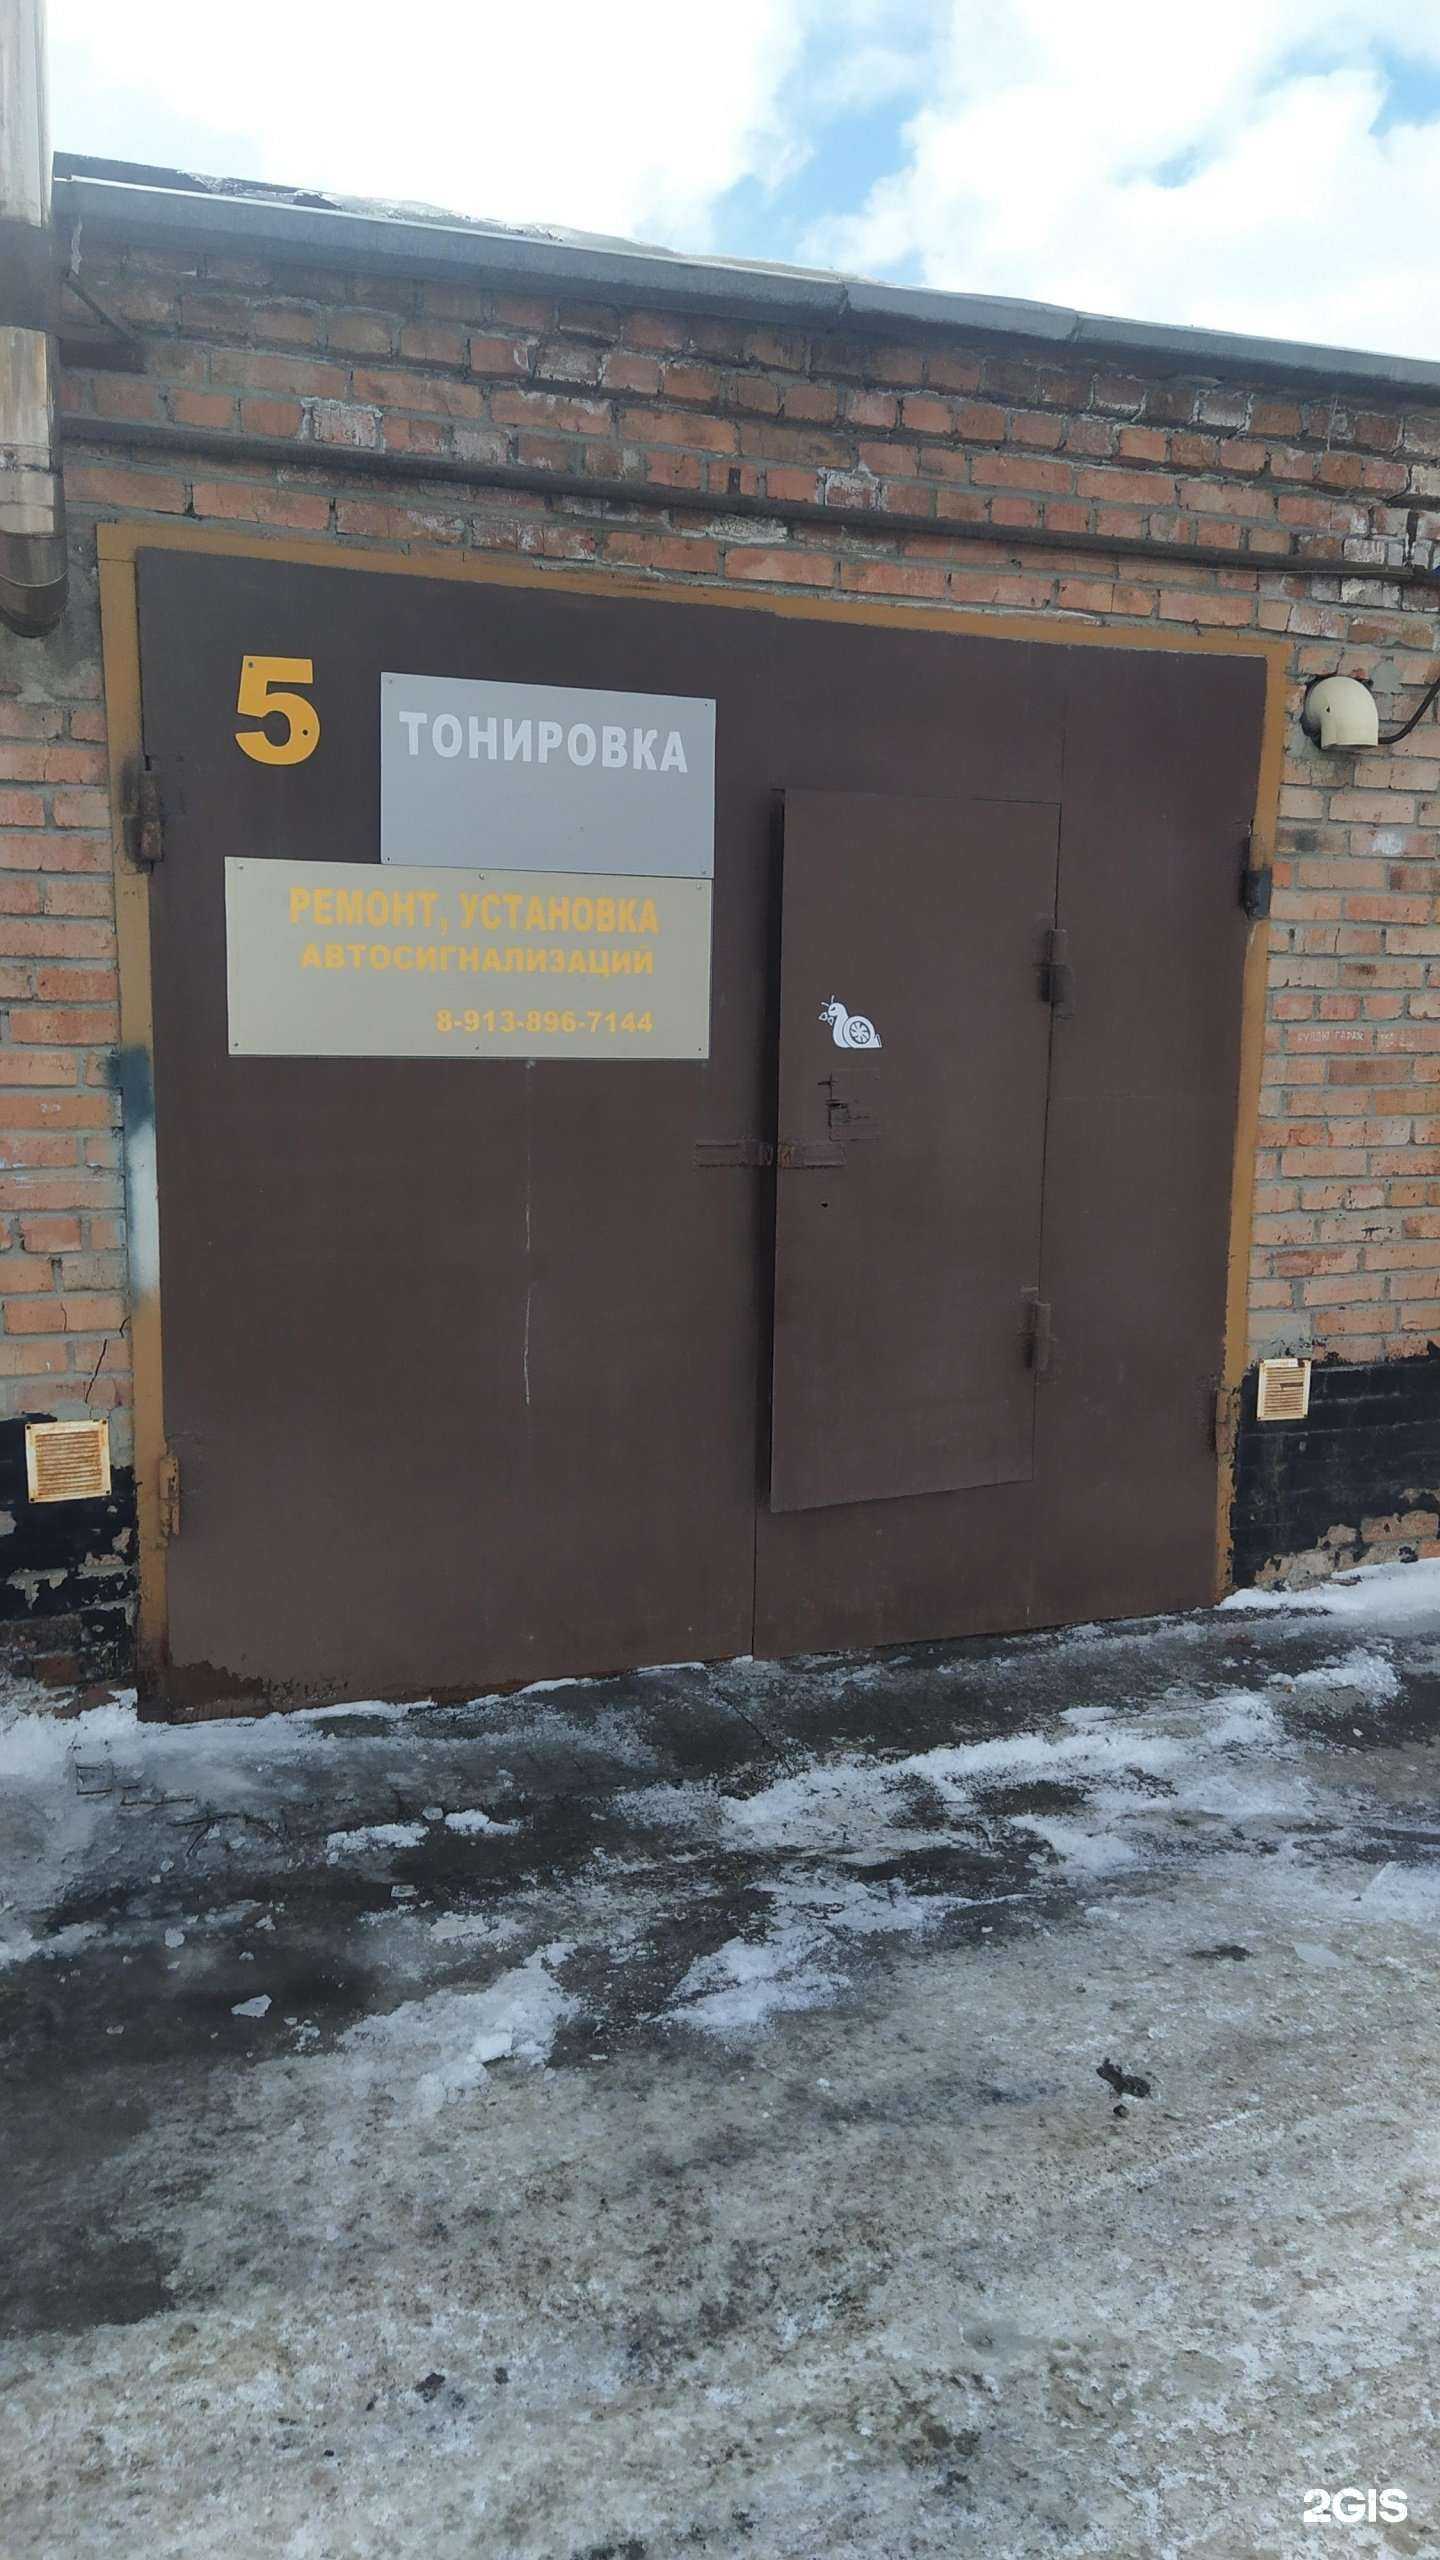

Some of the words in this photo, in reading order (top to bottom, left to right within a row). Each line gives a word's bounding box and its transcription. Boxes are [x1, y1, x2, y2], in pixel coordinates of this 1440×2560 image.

[235, 655, 321, 766] 5
[399, 710, 689, 774] ТОНИРОВКА
[288, 887, 449, 937] РЕМОНТ,
[458, 891, 661, 936] УСТАНОВКА
[301, 942, 656, 980] АВТОСИГНАЛИЗАЦИЙ
[434, 1008, 654, 1035] 8-913-896-7144
